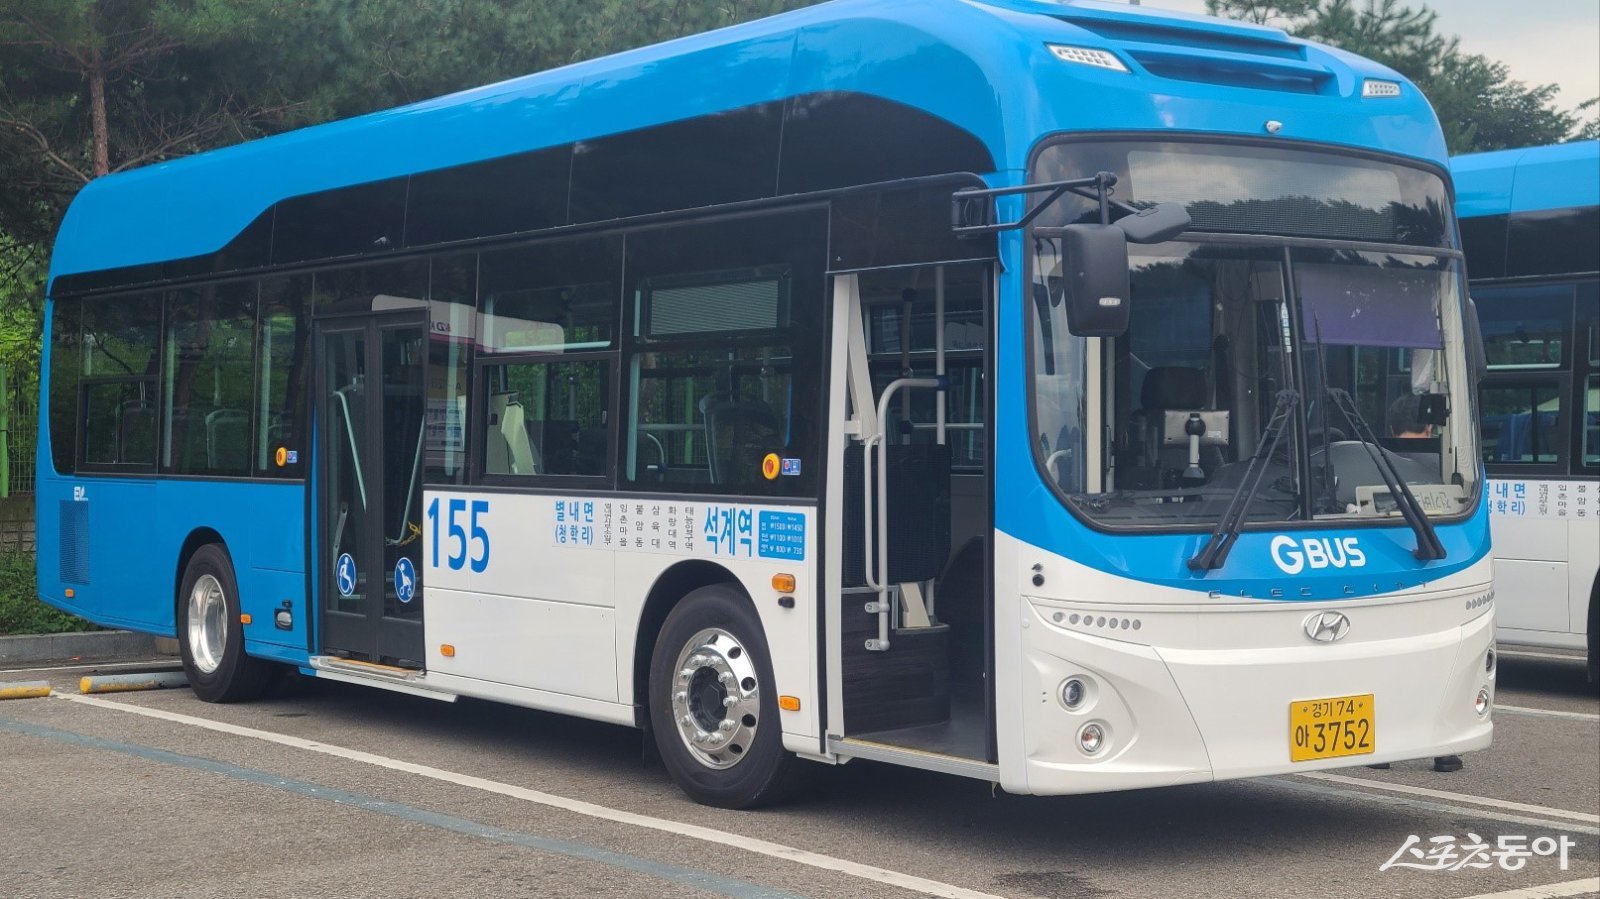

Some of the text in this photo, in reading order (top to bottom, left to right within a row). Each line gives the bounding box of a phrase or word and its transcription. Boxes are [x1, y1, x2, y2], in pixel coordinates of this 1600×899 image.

[555, 501, 593, 522] 별내면
[635, 504, 644, 548] 불암동
[651, 505, 660, 548] 삼육대
[668, 506, 677, 550] 화랑대역
[704, 506, 752, 557] 석계역
[427, 497, 490, 573] 155
[555, 525, 593, 545] (청학리)
[1312, 700, 1354, 718] 경기 74
